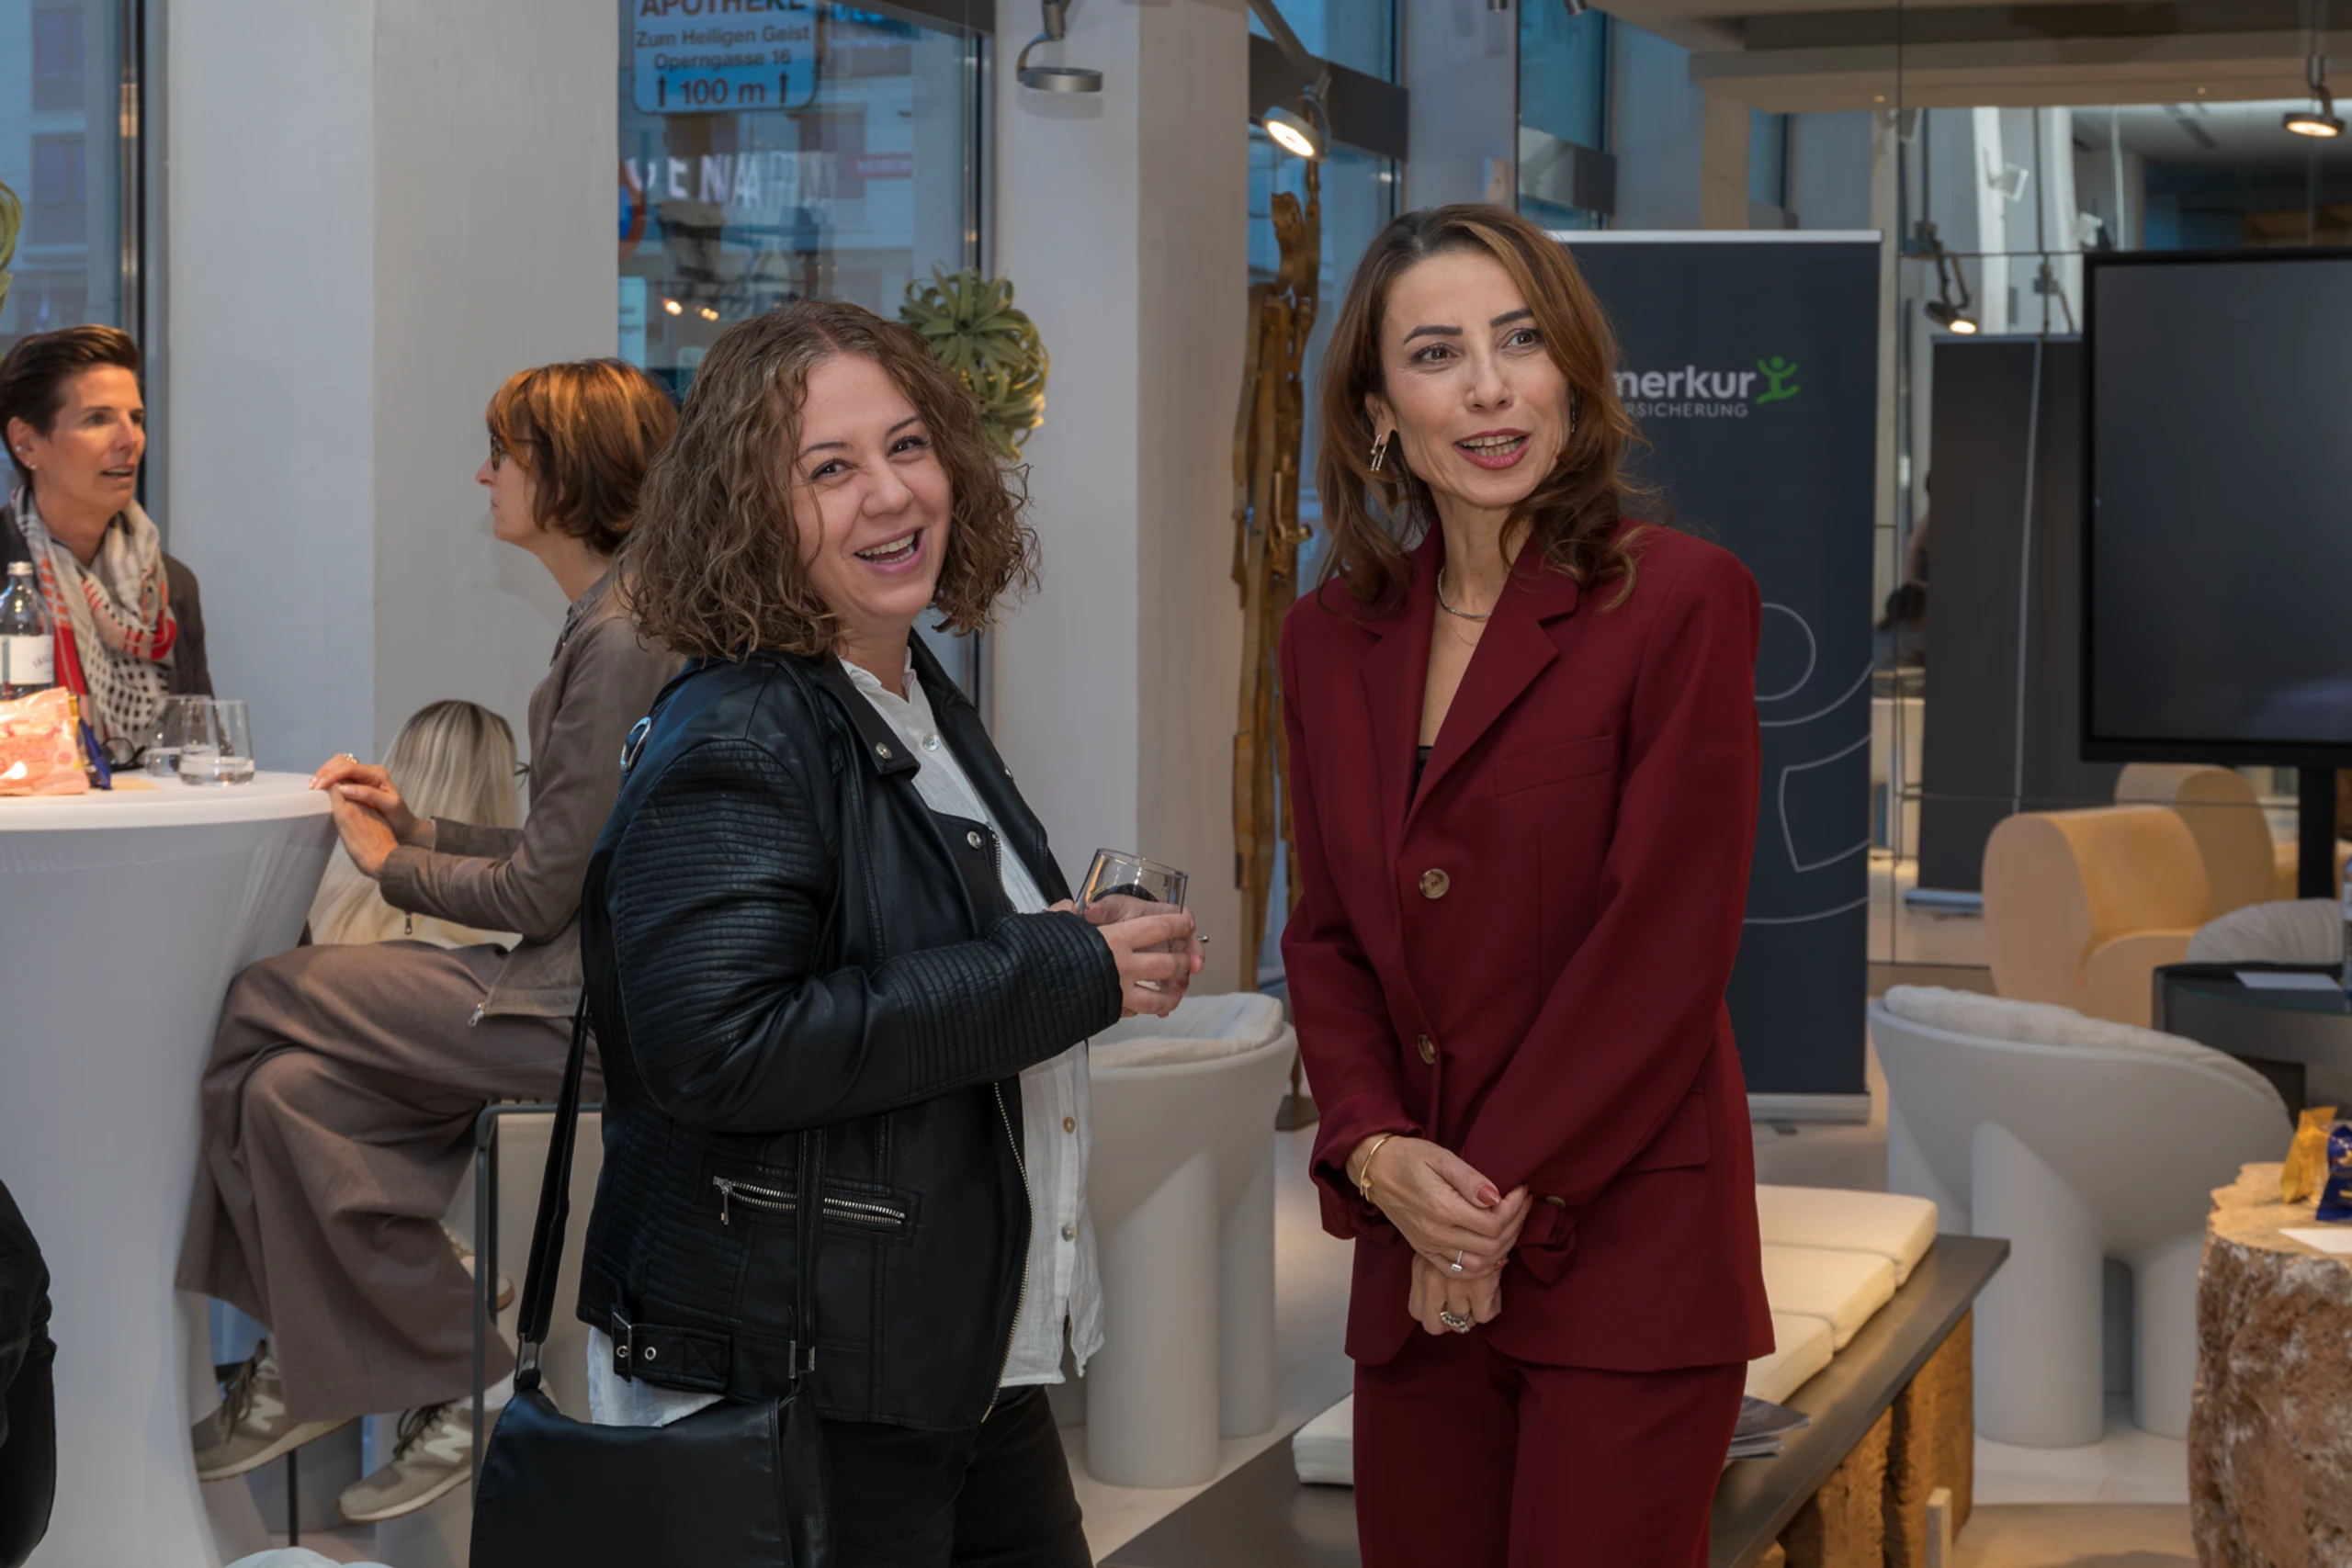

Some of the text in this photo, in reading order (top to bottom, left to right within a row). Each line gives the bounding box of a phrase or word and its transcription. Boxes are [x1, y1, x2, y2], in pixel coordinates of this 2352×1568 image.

[637, 24, 810, 47] Zum Heiligen Geist
[653, 48, 792, 72] Operngasse 16
[681, 77, 765, 105] 100 m
[1624, 401, 1748, 417] RSICHERUNG
